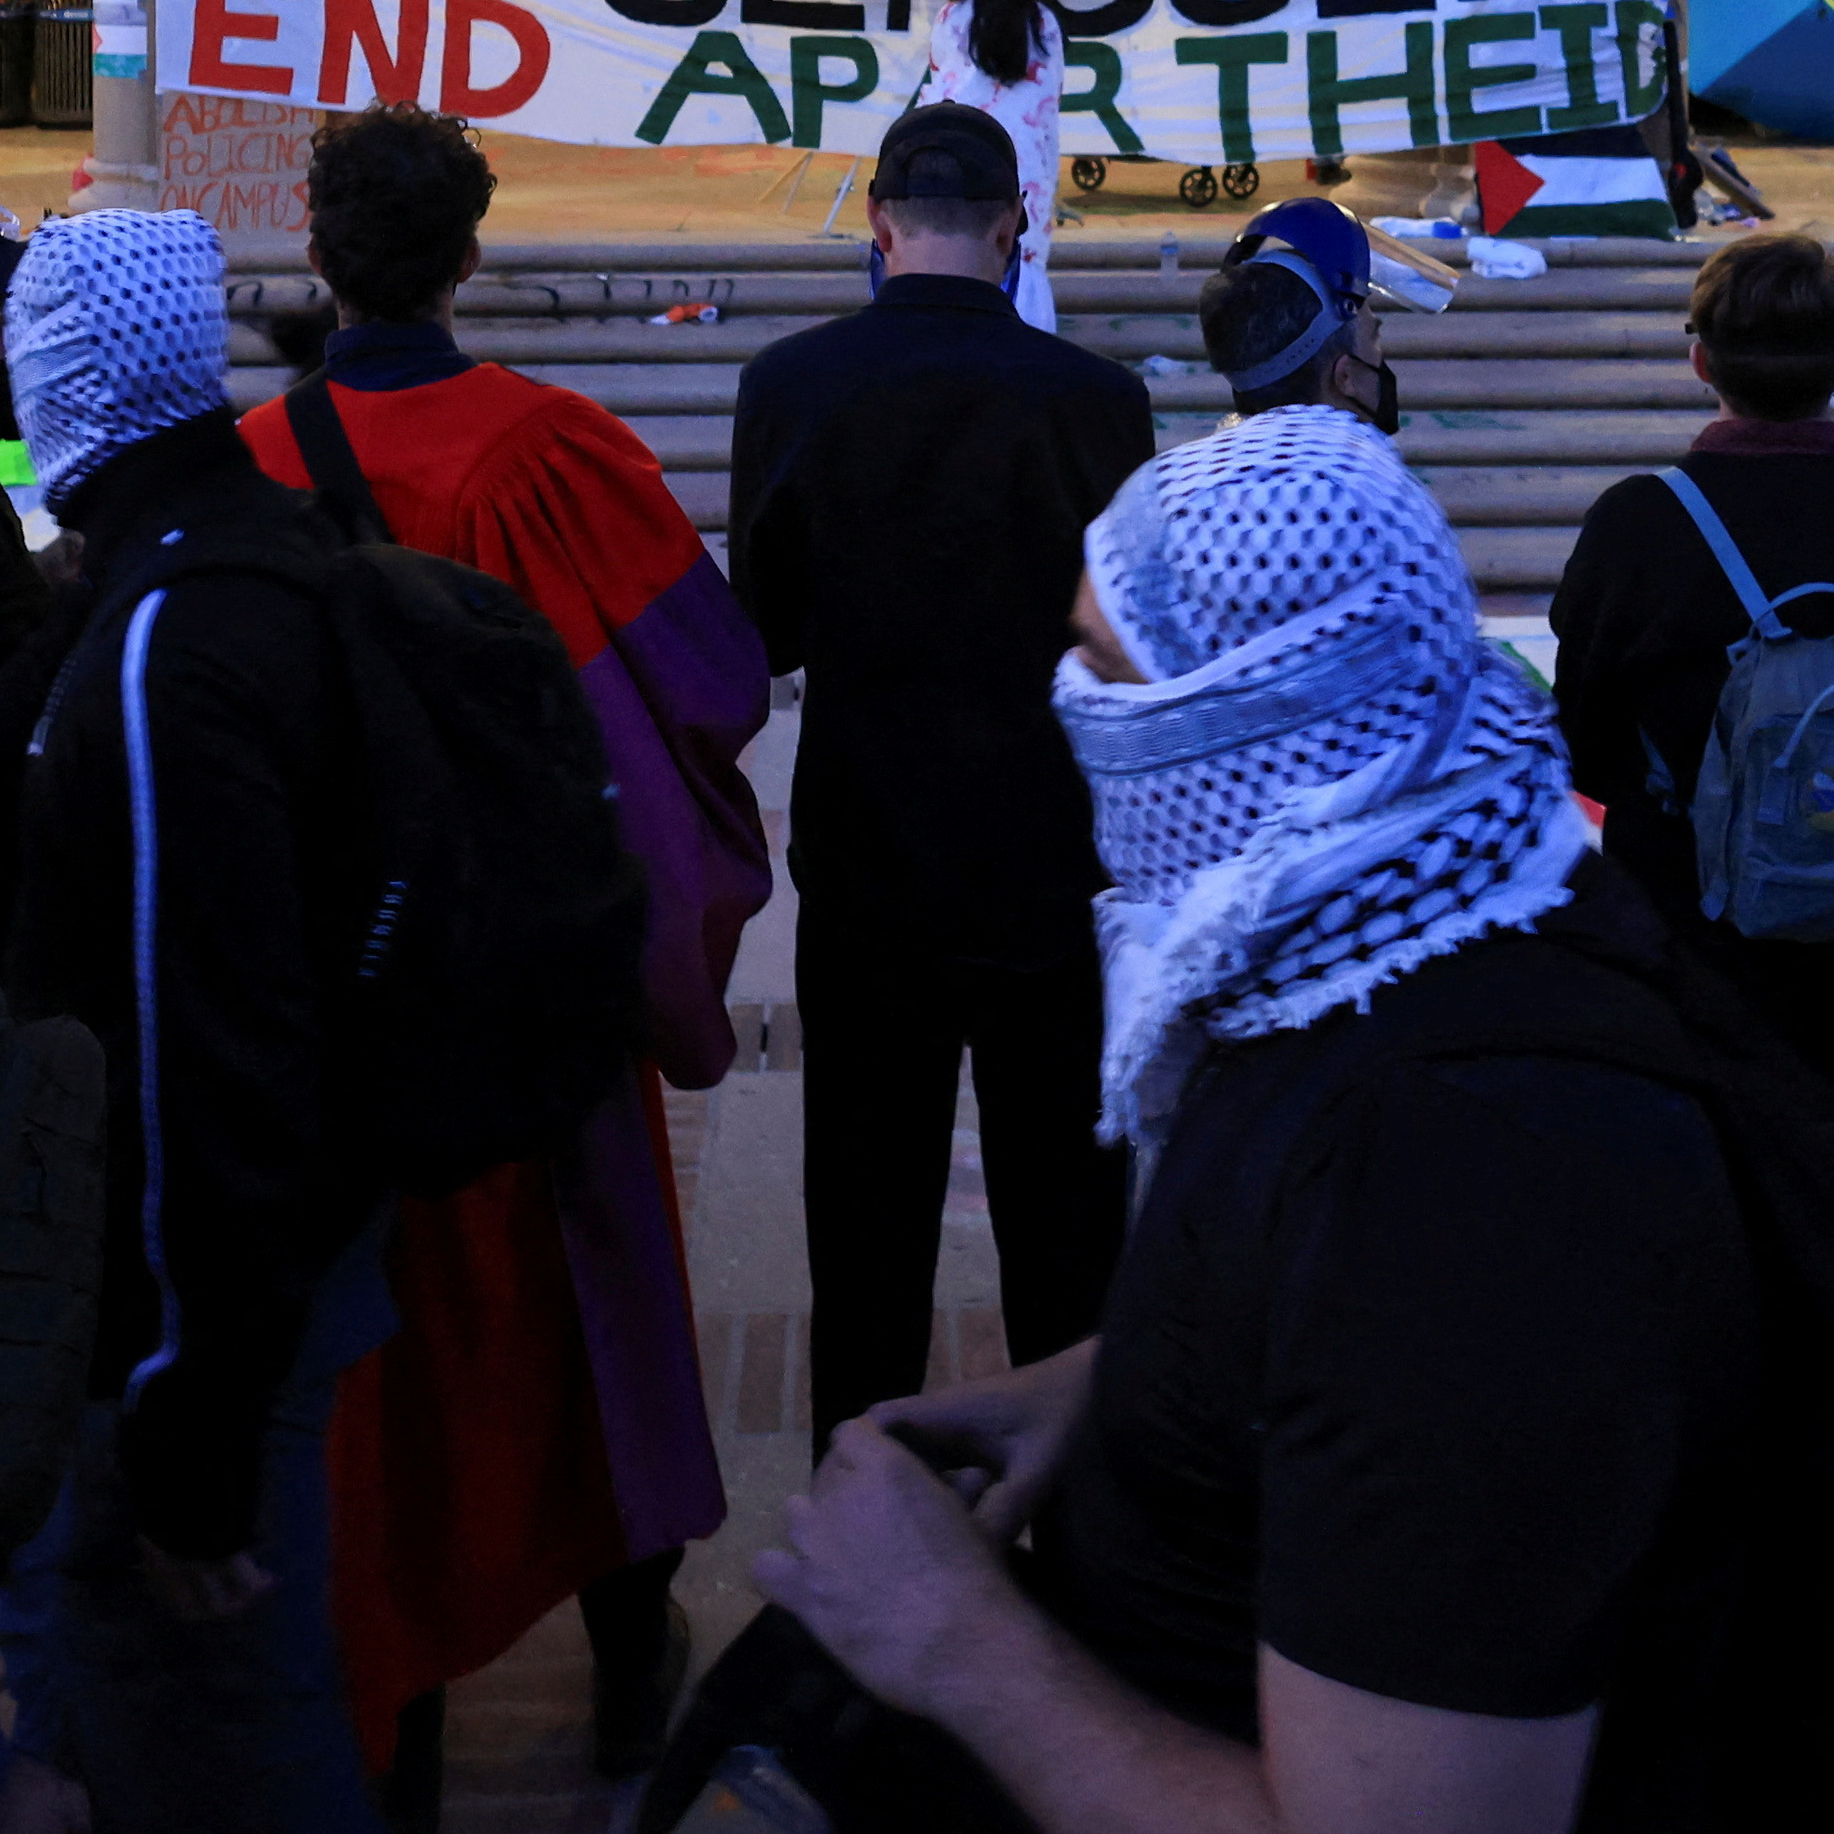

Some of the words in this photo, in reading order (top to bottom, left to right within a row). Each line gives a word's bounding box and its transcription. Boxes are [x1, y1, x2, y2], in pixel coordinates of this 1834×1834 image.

[635, 0, 1668, 164] APRTHEID
[163, 133, 313, 180] POLICING
[196, 181, 314, 233] CAMPUS
